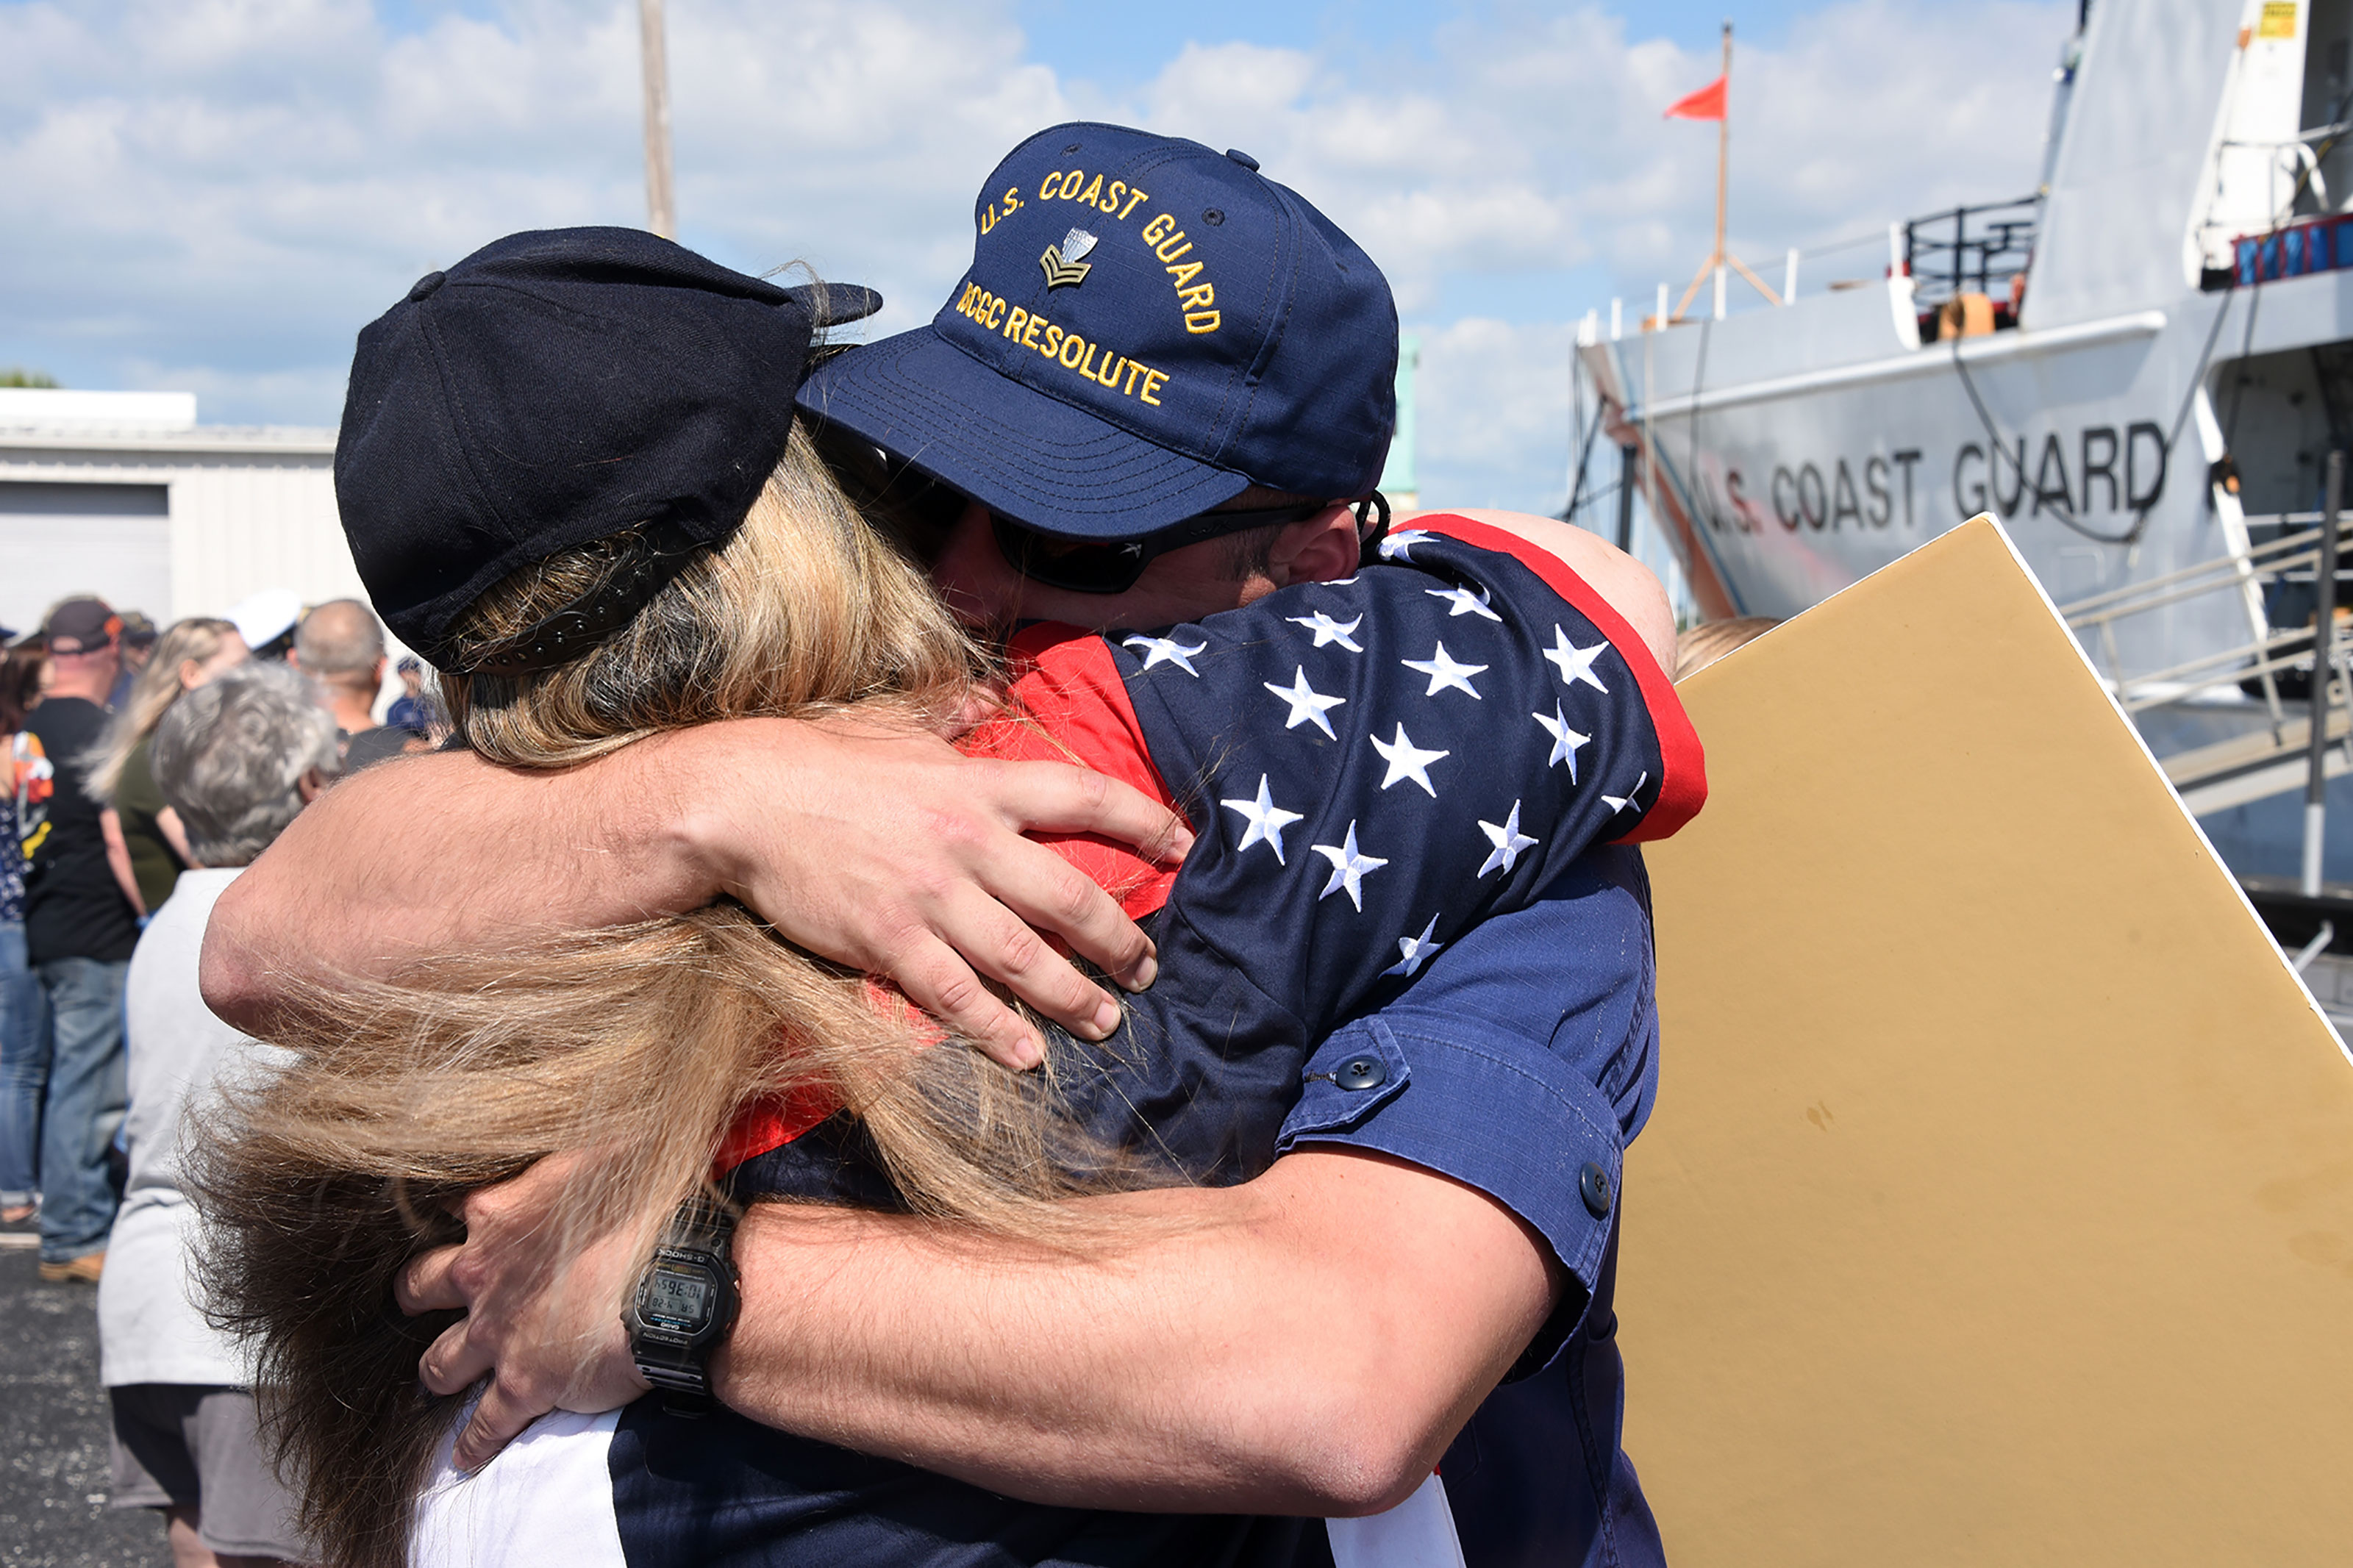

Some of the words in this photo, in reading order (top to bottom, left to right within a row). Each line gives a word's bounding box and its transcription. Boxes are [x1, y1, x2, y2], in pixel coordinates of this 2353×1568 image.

[980, 187, 1024, 235] U.S.
[1039, 170, 1149, 220] COAST
[1141, 212, 1221, 334] GUARD
[1003, 306, 1170, 406] RESOLUTE
[1771, 449, 1924, 534] COAST
[1952, 420, 2168, 521] GUARD
[658, 1248, 705, 1262] G-SHOCK
